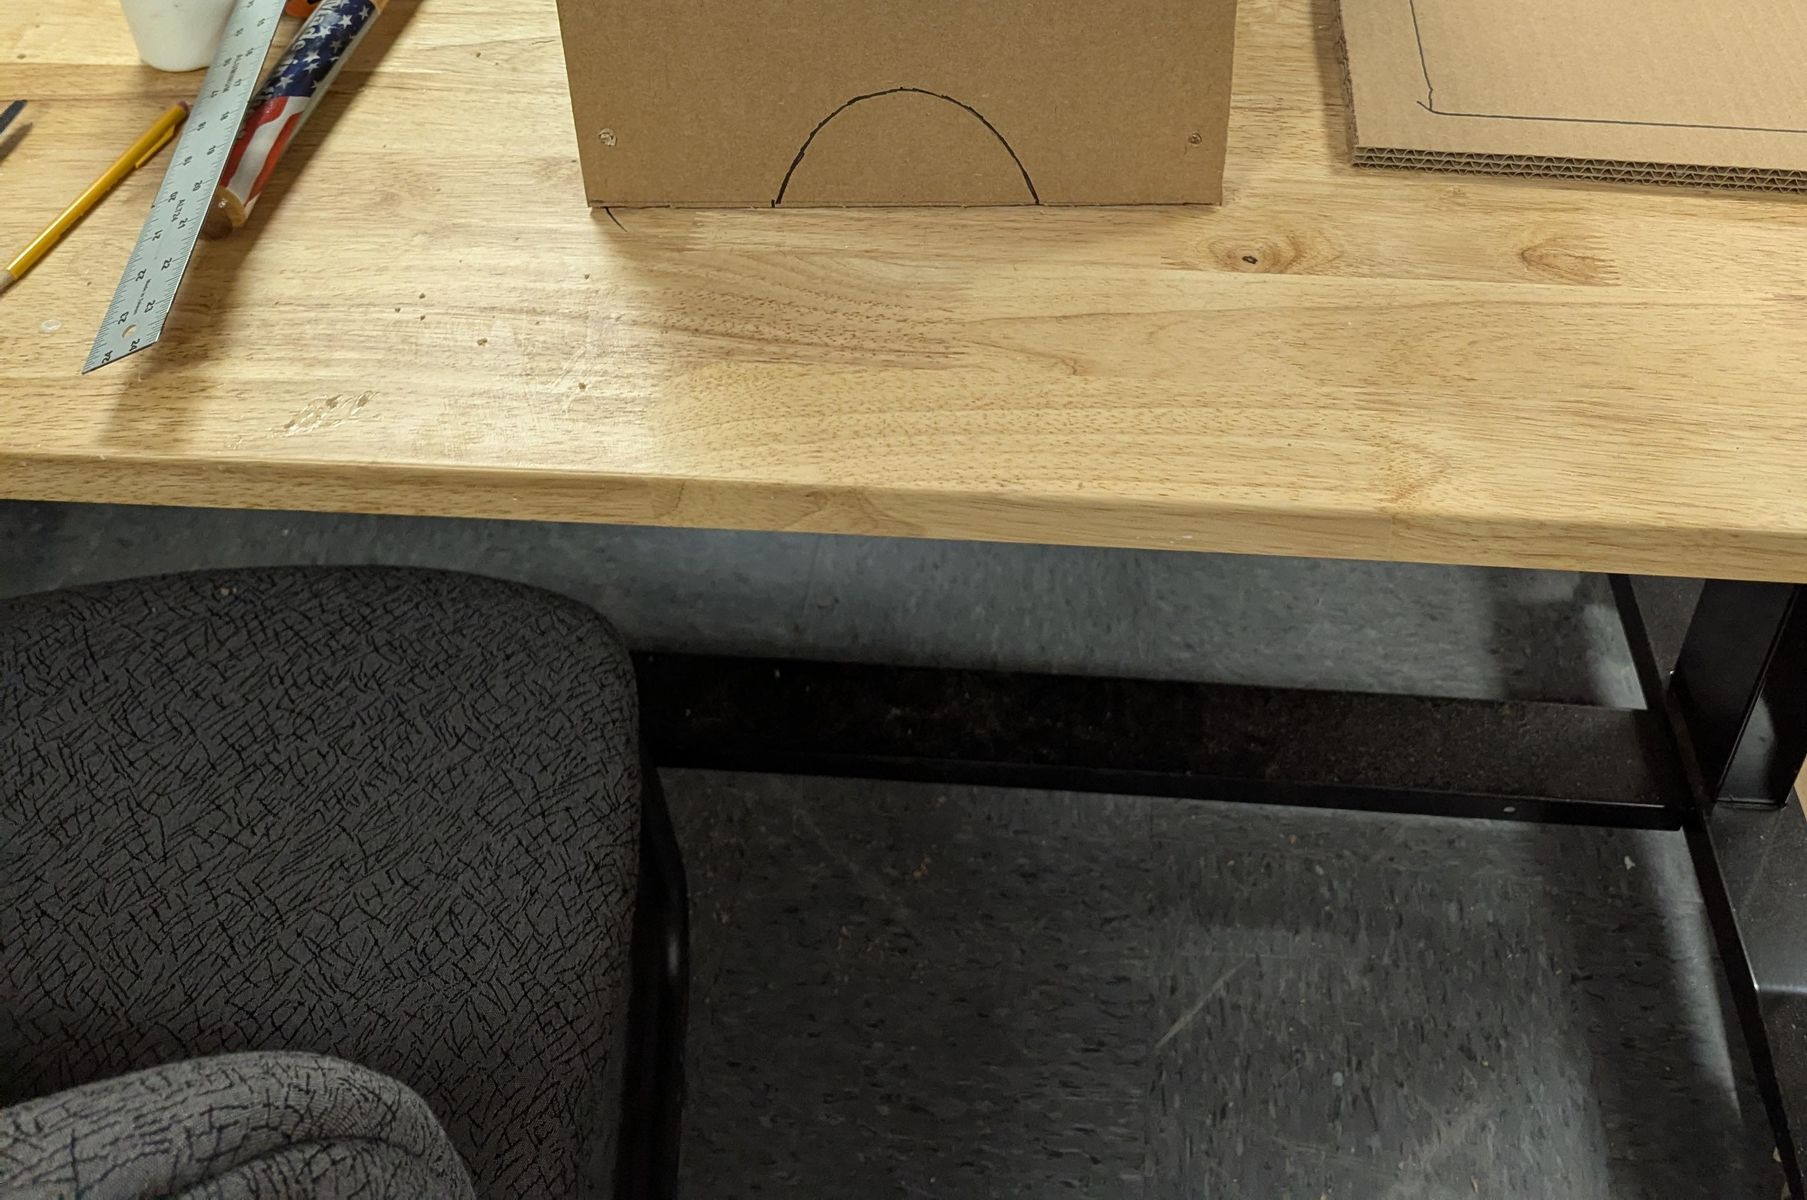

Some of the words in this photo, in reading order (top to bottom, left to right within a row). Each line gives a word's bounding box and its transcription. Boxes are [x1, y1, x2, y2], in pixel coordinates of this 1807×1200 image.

[192, 180, 203, 192] 20
[171, 199, 186, 222] ALT24
[178, 218, 188, 229] 21
[152, 229, 163, 241] 21
[161, 258, 172, 271] 22
[136, 268, 146, 282] 22
[144, 300, 156, 313] 23
[118, 311, 129, 324] 23
[129, 338, 140, 351] 24
[102, 350, 113, 364] 24
